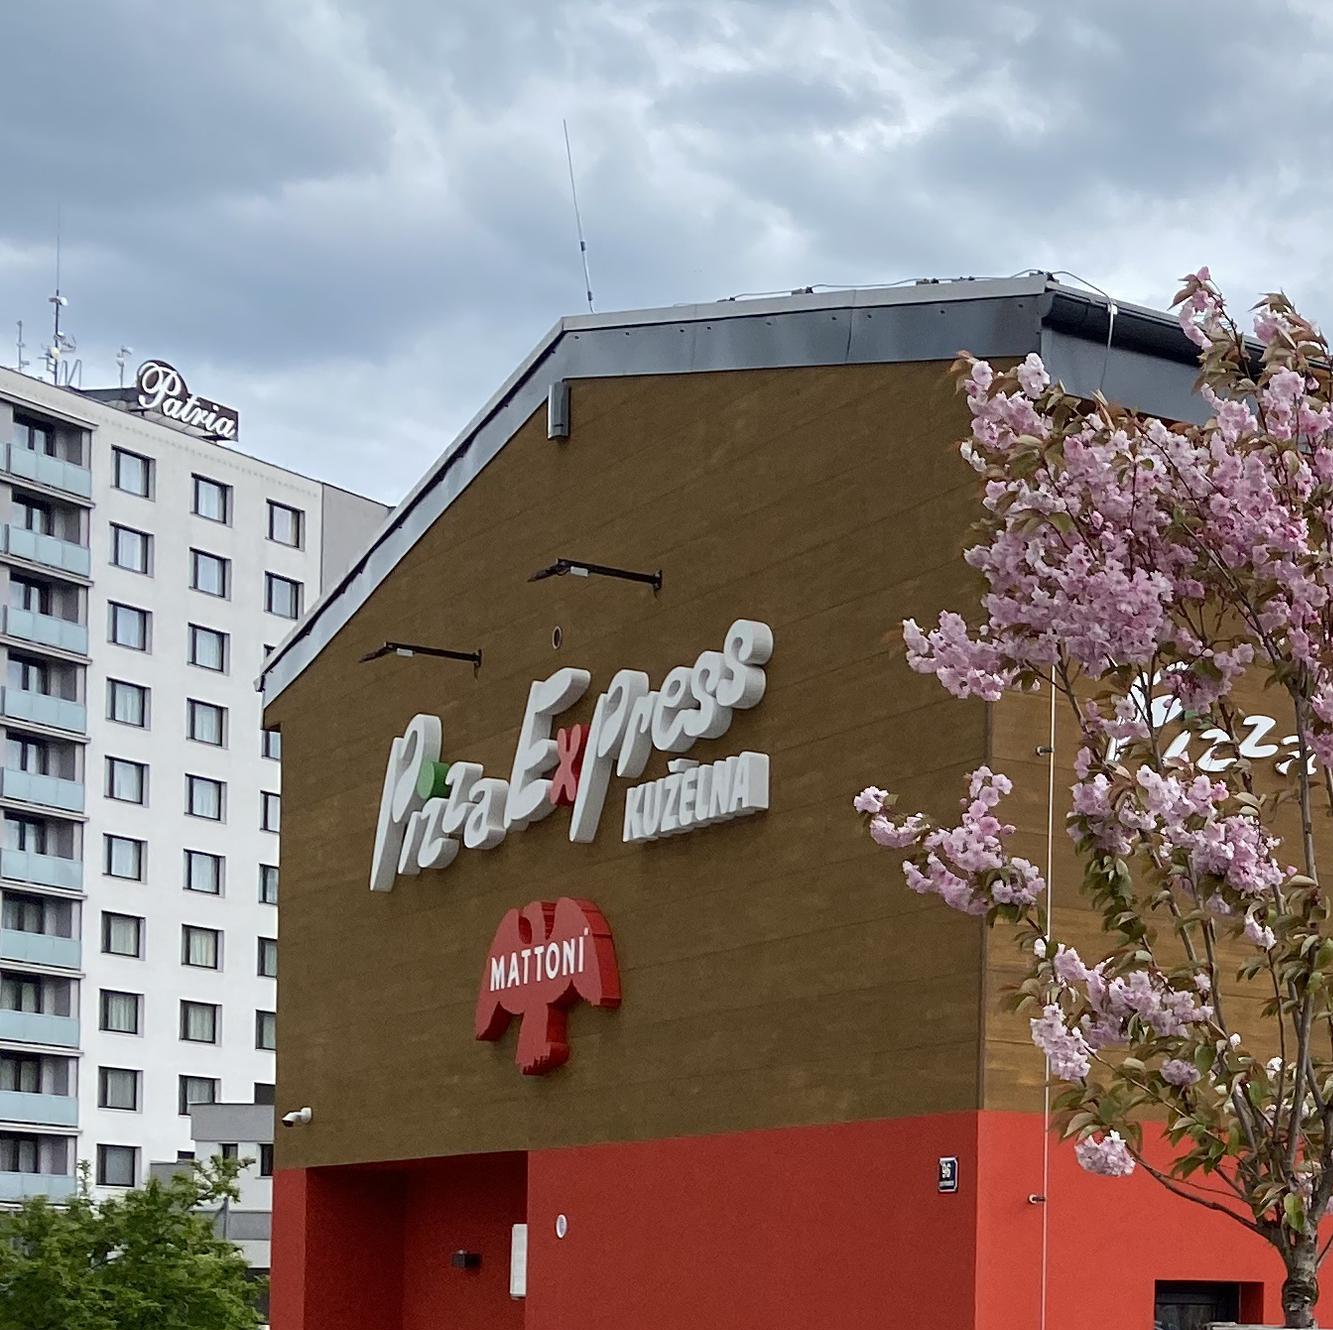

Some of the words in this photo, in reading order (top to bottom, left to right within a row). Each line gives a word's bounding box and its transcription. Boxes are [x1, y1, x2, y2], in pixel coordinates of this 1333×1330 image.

[139, 362, 235, 437] Patria
[370, 713, 510, 892] Pizza
[503, 619, 774, 843] Express
[623, 751, 770, 843] KUŽELNA
